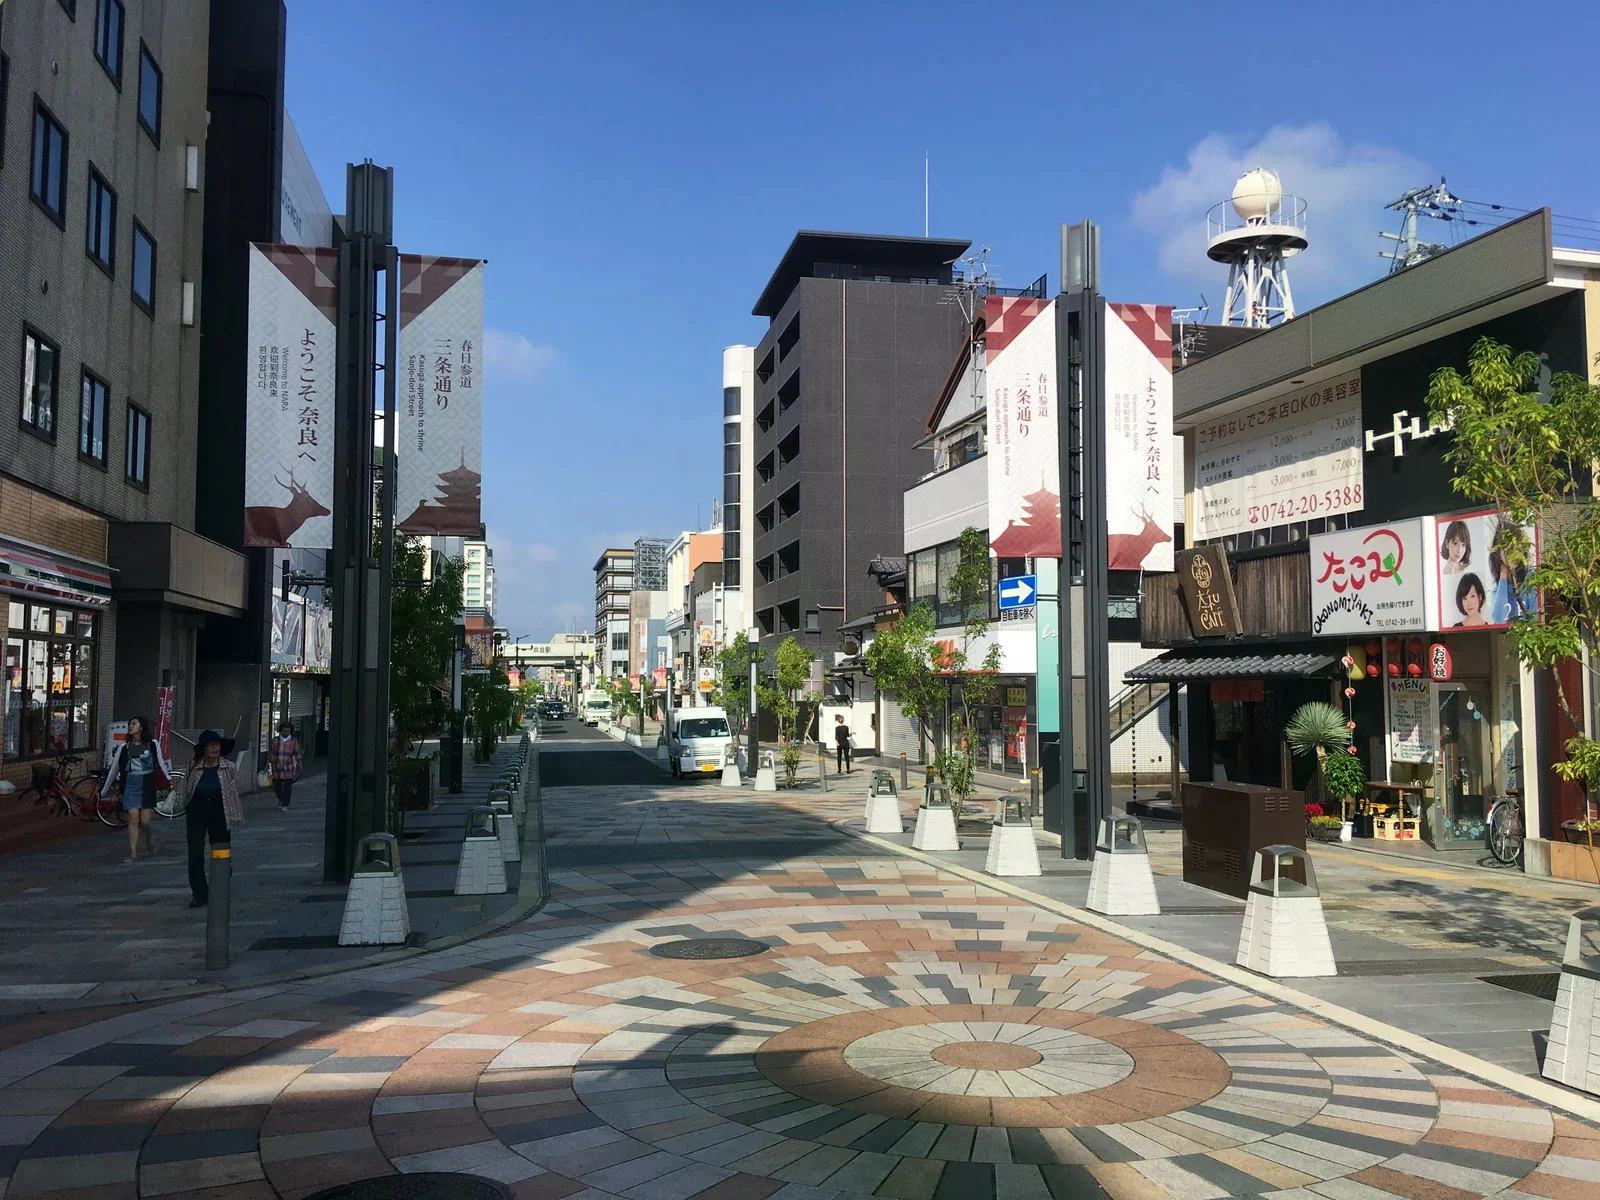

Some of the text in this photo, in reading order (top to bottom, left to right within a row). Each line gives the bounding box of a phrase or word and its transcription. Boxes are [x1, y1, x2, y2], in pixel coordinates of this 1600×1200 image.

[258, 345, 267, 389] 환영합니다
[407, 354, 416, 393] Sanjo-dori
[417, 354, 425, 381] Kasuga
[433, 338, 452, 411] 三条通り
[459, 339, 472, 388] 春日参道
[297, 328, 319, 462] ようこそ奈良へ
[417, 382, 425, 419] approach
[1002, 387, 1010, 413] Kasuga
[1015, 372, 1032, 438] 三条通り
[1038, 372, 1048, 418] 春日参道
[418, 420, 425, 428] to
[1145, 377, 1161, 495] ようこそ奈良へ
[1004, 446, 1010, 454] to
[1261, 483, 1362, 521] 0742-20-5388
[1002, 607, 1035, 622] 自転車を除く
[1313, 592, 1374, 634] OKONOMIYAKI
[1376, 619, 1384, 627] TEL
[1397, 679, 1426, 693] MENU
